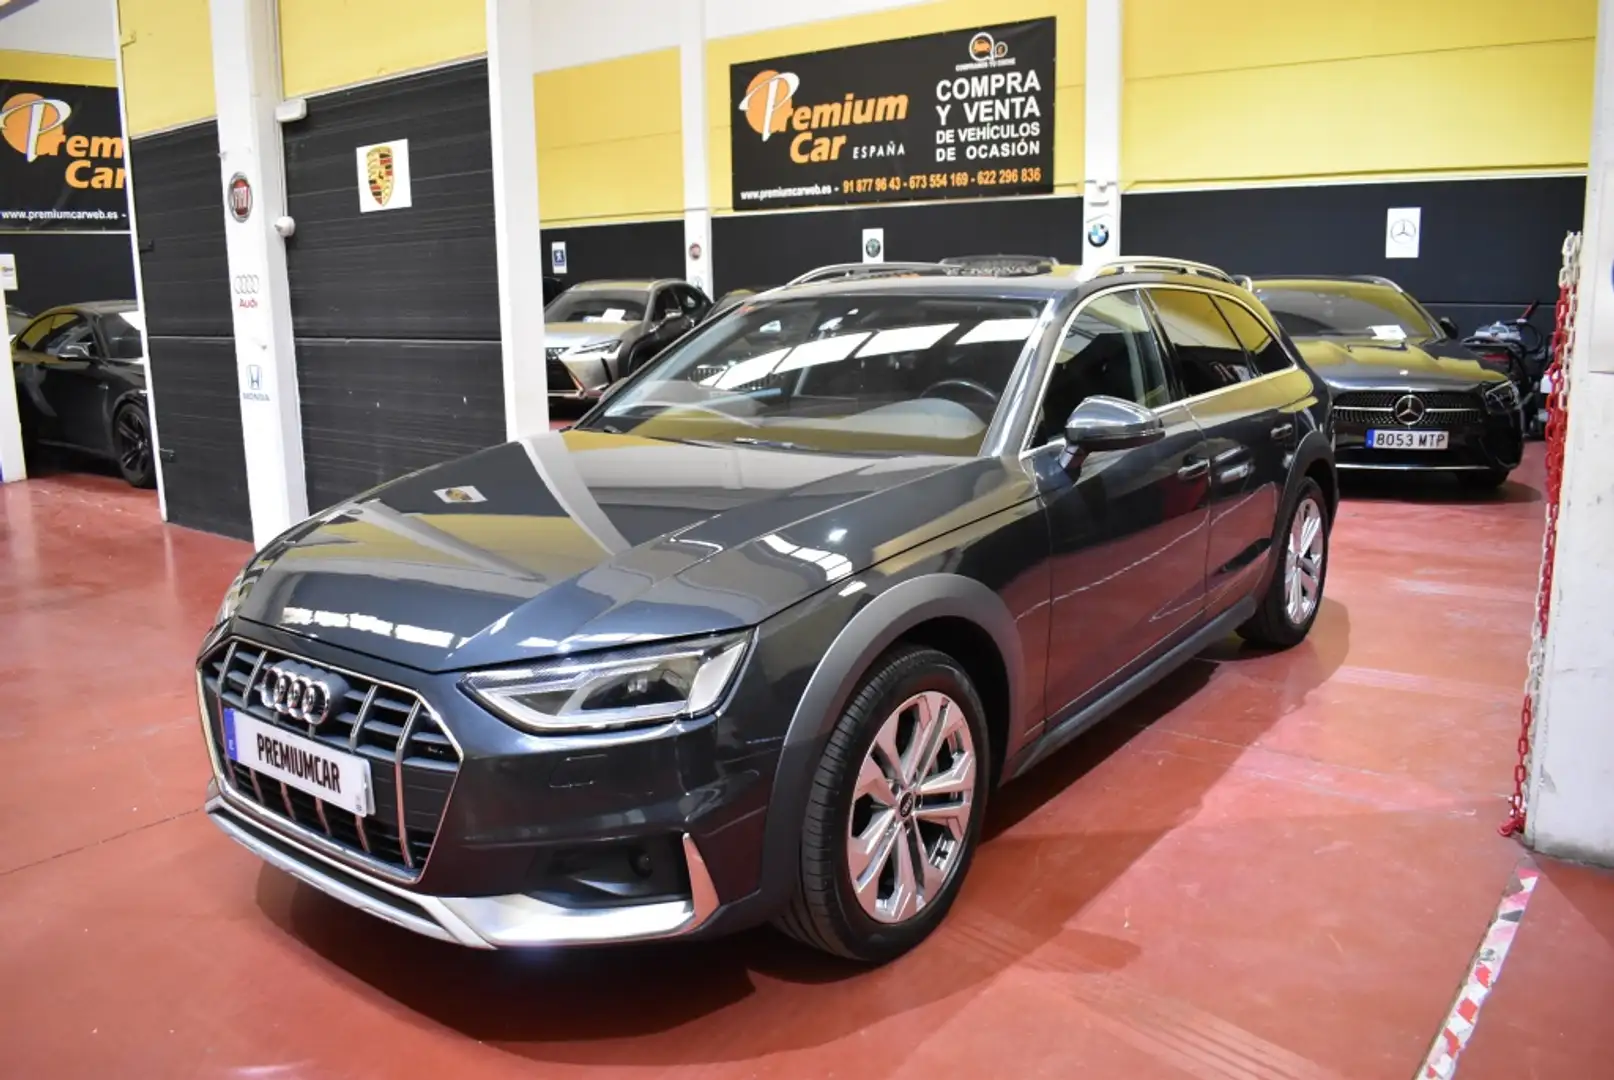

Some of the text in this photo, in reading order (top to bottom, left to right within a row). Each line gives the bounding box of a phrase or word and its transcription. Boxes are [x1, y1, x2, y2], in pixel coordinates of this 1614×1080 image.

[936, 69, 1041, 101] COMPRA
[739, 72, 908, 142] Premium
[936, 95, 1041, 126] Y VENTA
[790, 131, 905, 163] Car ESPAÑA
[936, 121, 1040, 144] DE VEHÍCULOS
[936, 138, 1040, 162] DE OCASIÓN
[740, 184, 831, 200] www.premiumcarweb.es
[843, 180, 854, 194] 91
[889, 176, 901, 191] 43
[909, 175, 927, 190] 673
[929, 173, 948, 189] 554
[977, 170, 997, 186] 622
[999, 168, 1018, 184] 296
[1021, 167, 1041, 183] 836
[1, 208, 118, 221] www.premiumcarweb.es
[1376, 433, 1414, 447] 8053
[1418, 433, 1445, 447] MTP
[257, 733, 341, 793] PREMIUMCAR
